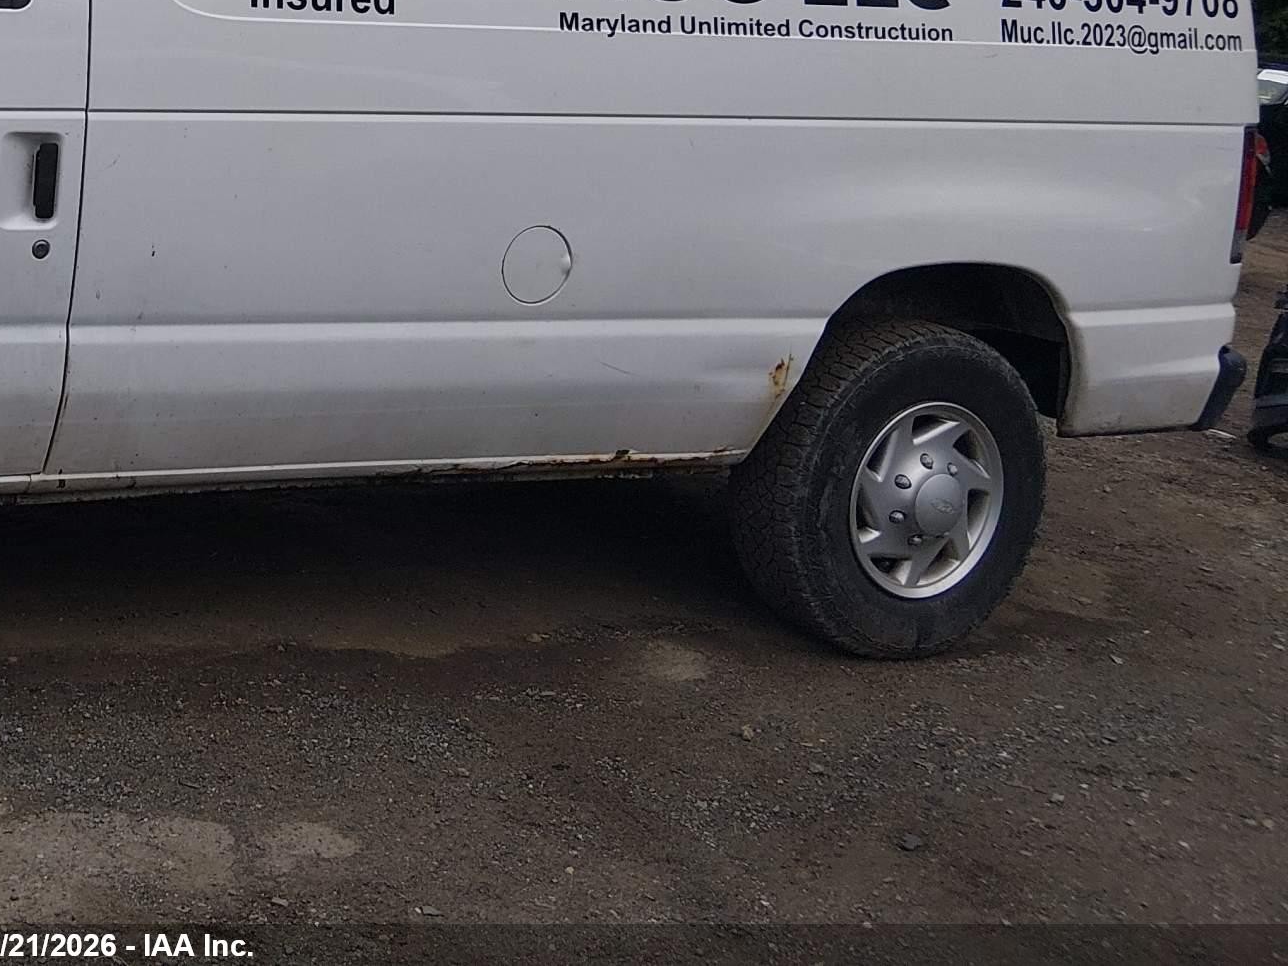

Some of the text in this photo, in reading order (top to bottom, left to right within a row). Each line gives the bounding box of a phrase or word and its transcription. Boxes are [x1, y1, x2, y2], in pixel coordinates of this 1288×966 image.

[559, 11, 953, 42] Maryland Unlimited Constructuion
[1000, 18, 1243, 56] Muc.llc.2023@gmail.com
